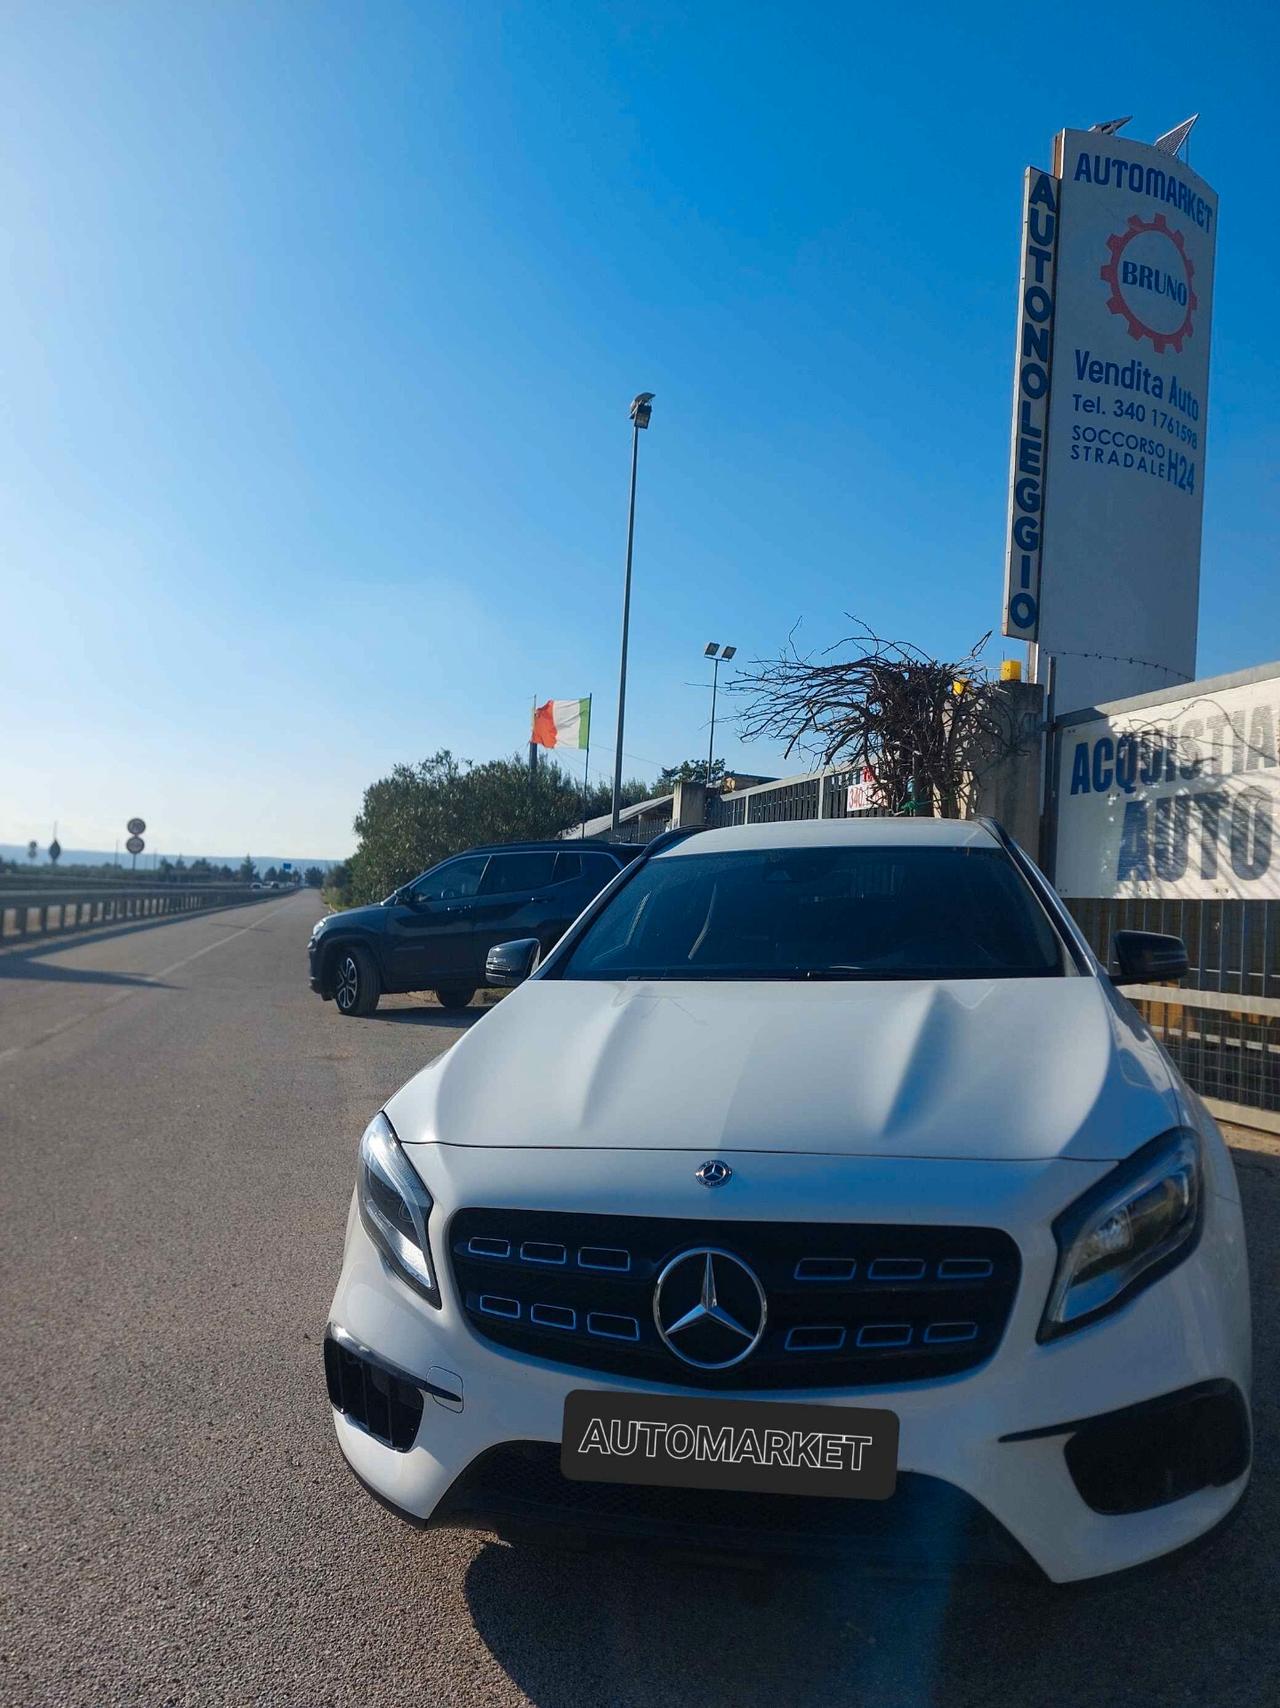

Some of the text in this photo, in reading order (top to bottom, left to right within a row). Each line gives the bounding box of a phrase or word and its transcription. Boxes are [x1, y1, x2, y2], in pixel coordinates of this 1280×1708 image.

[1073, 152, 1213, 234] AUTOMARKET
[1122, 260, 1188, 307] BRUNO
[1009, 174, 1056, 630] AUTONOLEGGIO
[1075, 349, 1199, 421] Vendita Auto
[1071, 425, 1165, 459] SOCCORSO
[1072, 393, 1198, 450] Tel. 340 1761598
[1070, 444, 1165, 478] STRADALE
[1167, 448, 1195, 495] H24
[1116, 785, 1274, 883] AUTO
